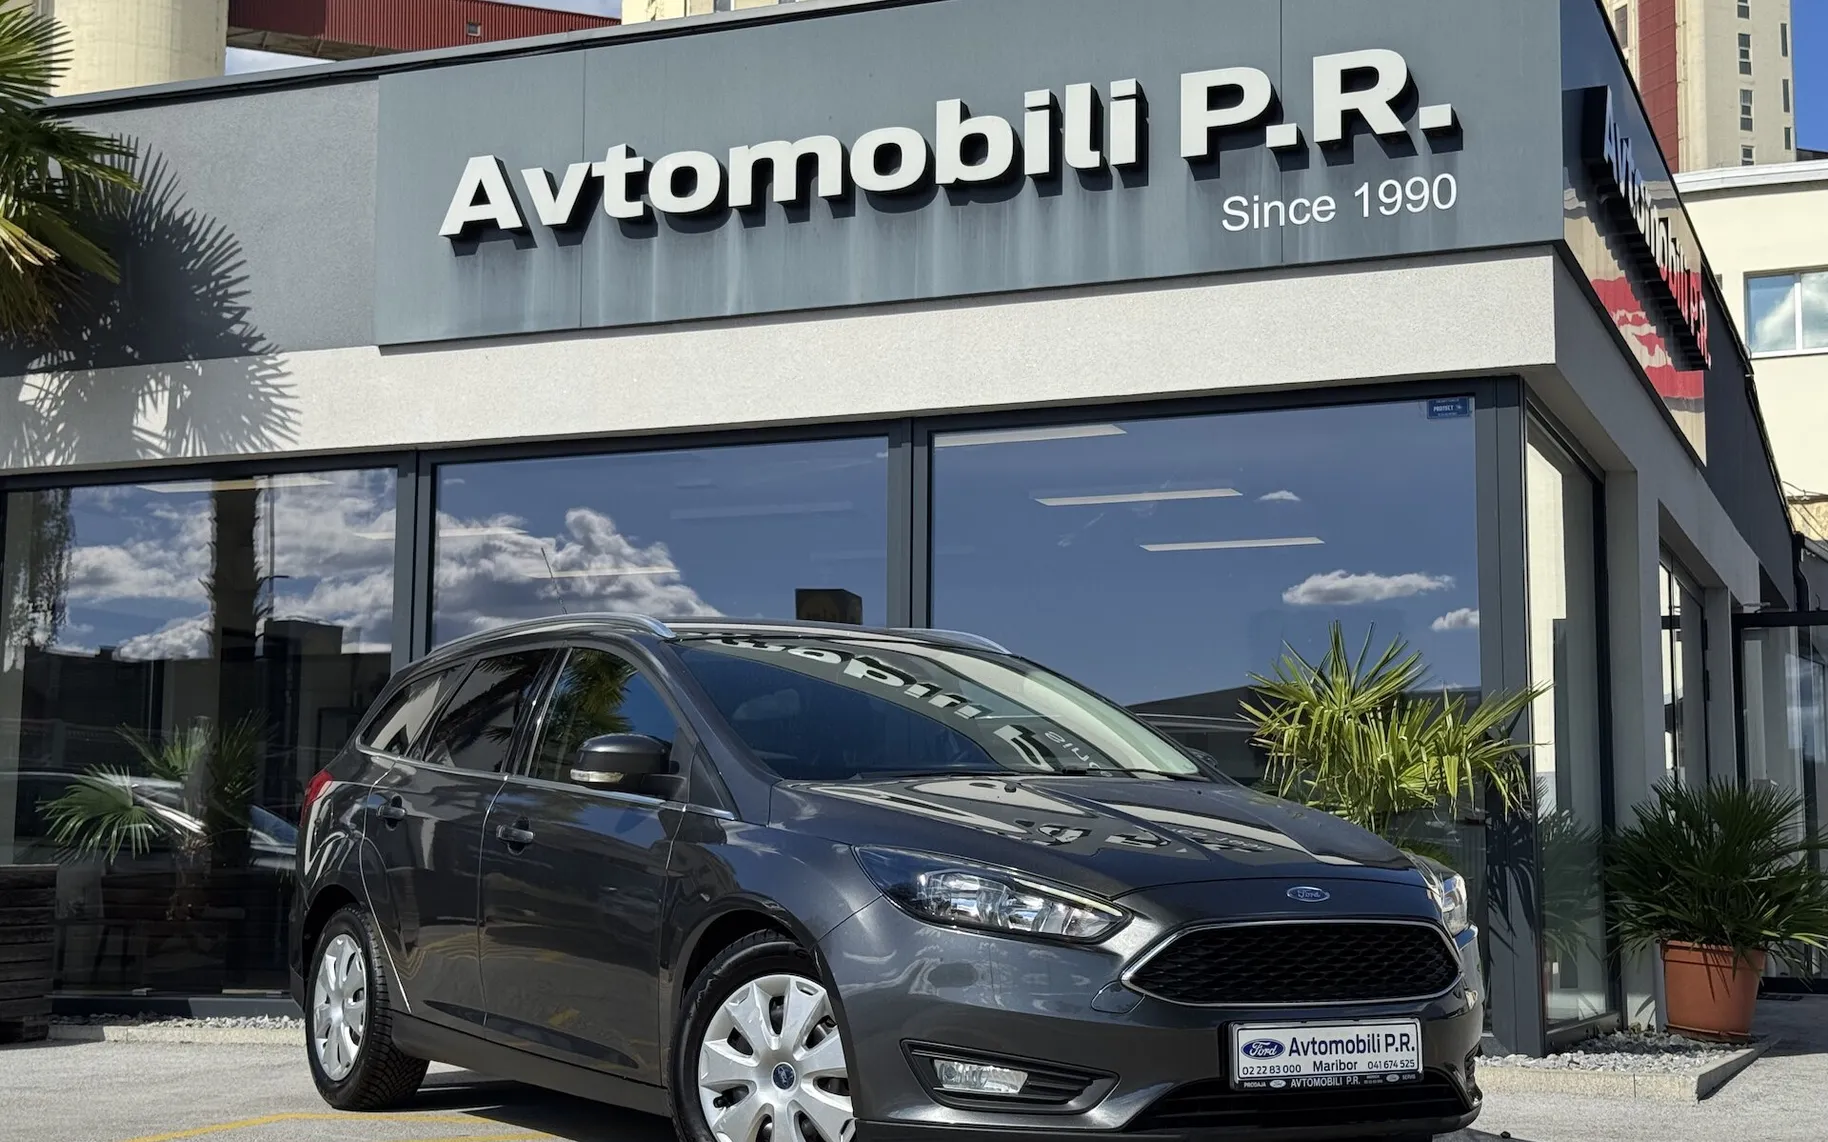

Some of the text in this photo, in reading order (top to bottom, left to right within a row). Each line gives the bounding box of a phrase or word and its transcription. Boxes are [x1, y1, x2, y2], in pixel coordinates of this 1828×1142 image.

[439, 48, 1453, 237] Avtomobili P.R.
[1222, 172, 1458, 232] Since 1990
[1288, 1033, 1381, 1057] Avtomobili
[1384, 1032, 1416, 1053] P.R.
[1242, 1059, 1415, 1075] 02 22 83 000 Maribor 041 674 525
[1290, 1076, 1343, 1088] AVTOMOBILI
[1346, 1076, 1361, 1085] P.R.
